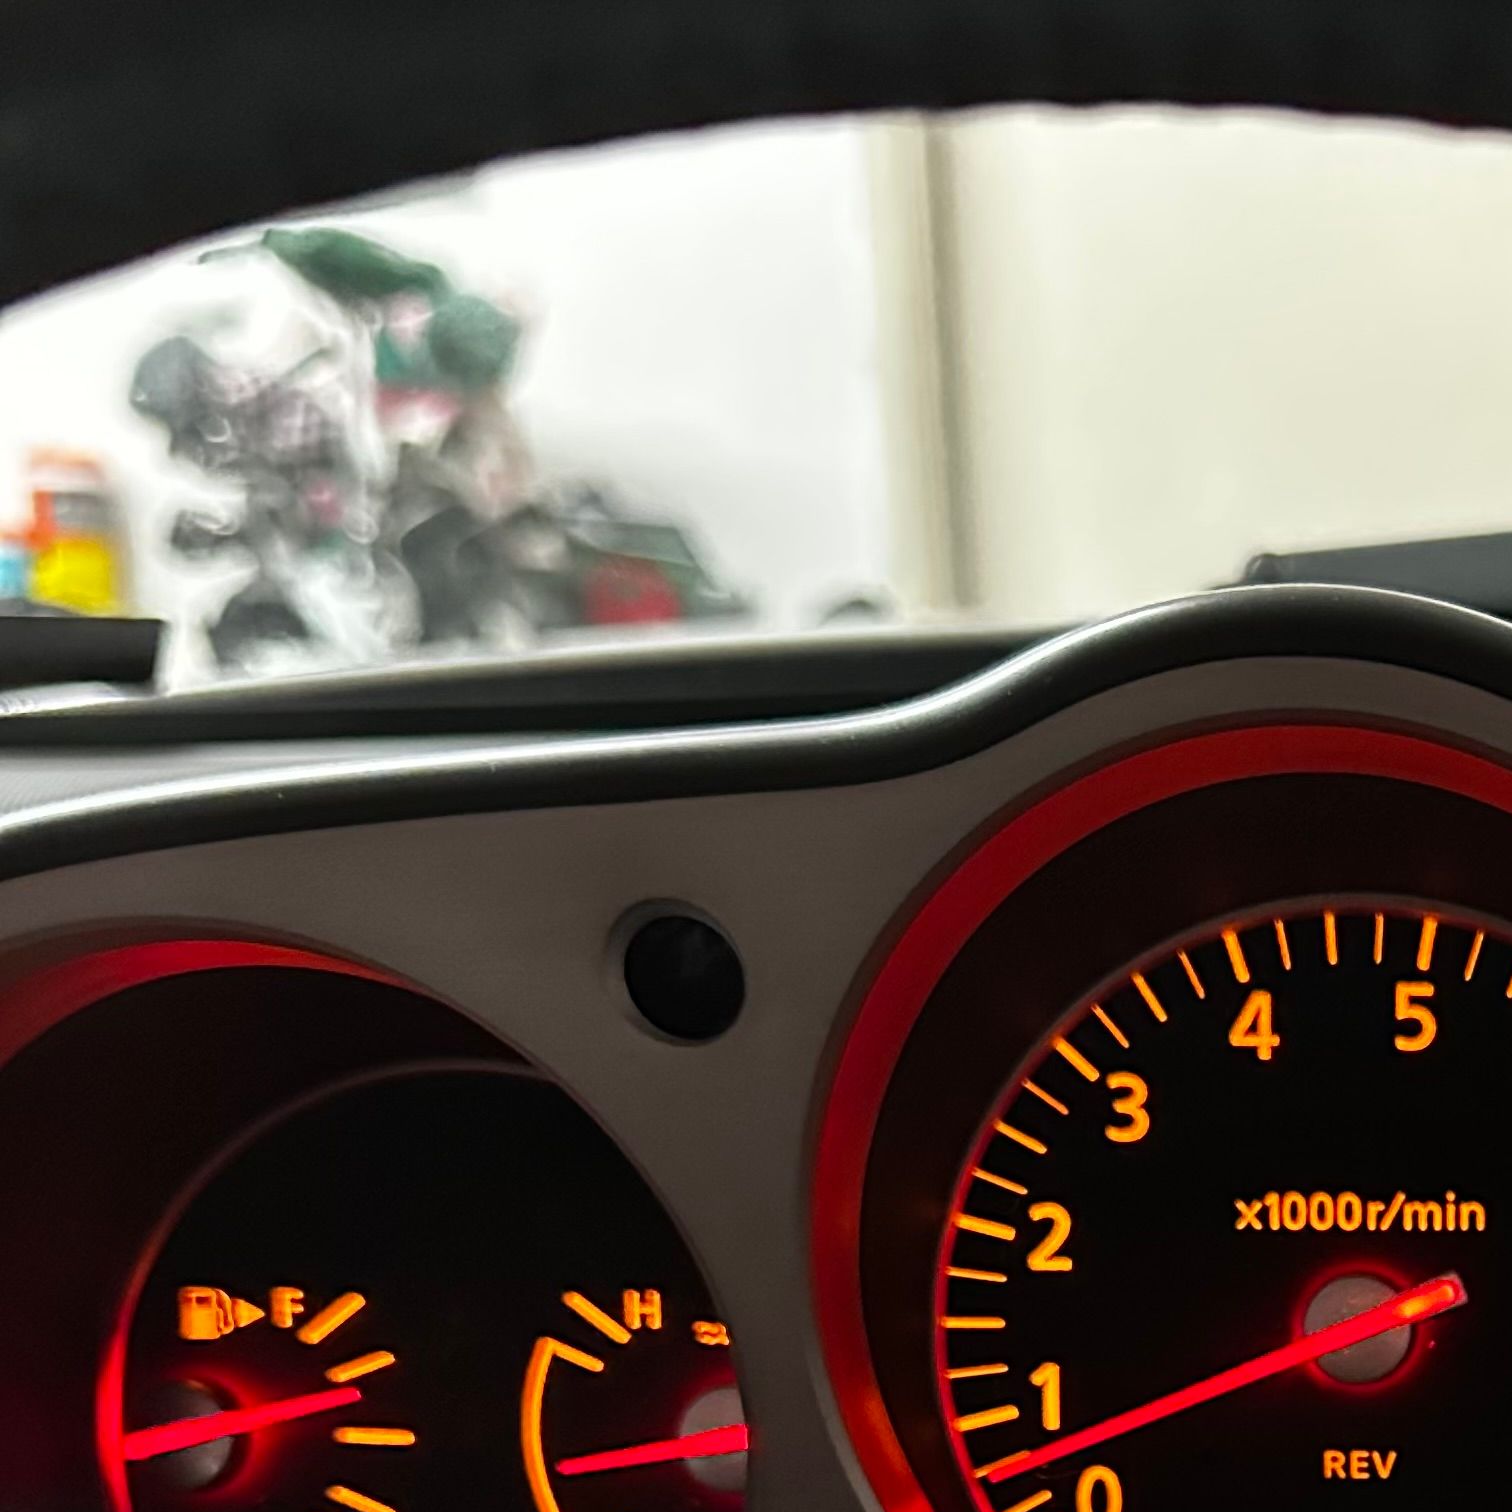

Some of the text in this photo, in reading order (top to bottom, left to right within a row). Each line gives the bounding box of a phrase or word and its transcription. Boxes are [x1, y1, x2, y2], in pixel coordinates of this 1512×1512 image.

[1229, 991, 1280, 1060] 4
[1395, 982, 1436, 1051] 5
[1105, 1072, 1150, 1142] 3
[1027, 1202, 1073, 1271] 2
[271, 1286, 304, 1328] F
[623, 1289, 662, 1330] H
[1029, 1362, 1061, 1430] 1
[1323, 1450, 1397, 1479] REV
